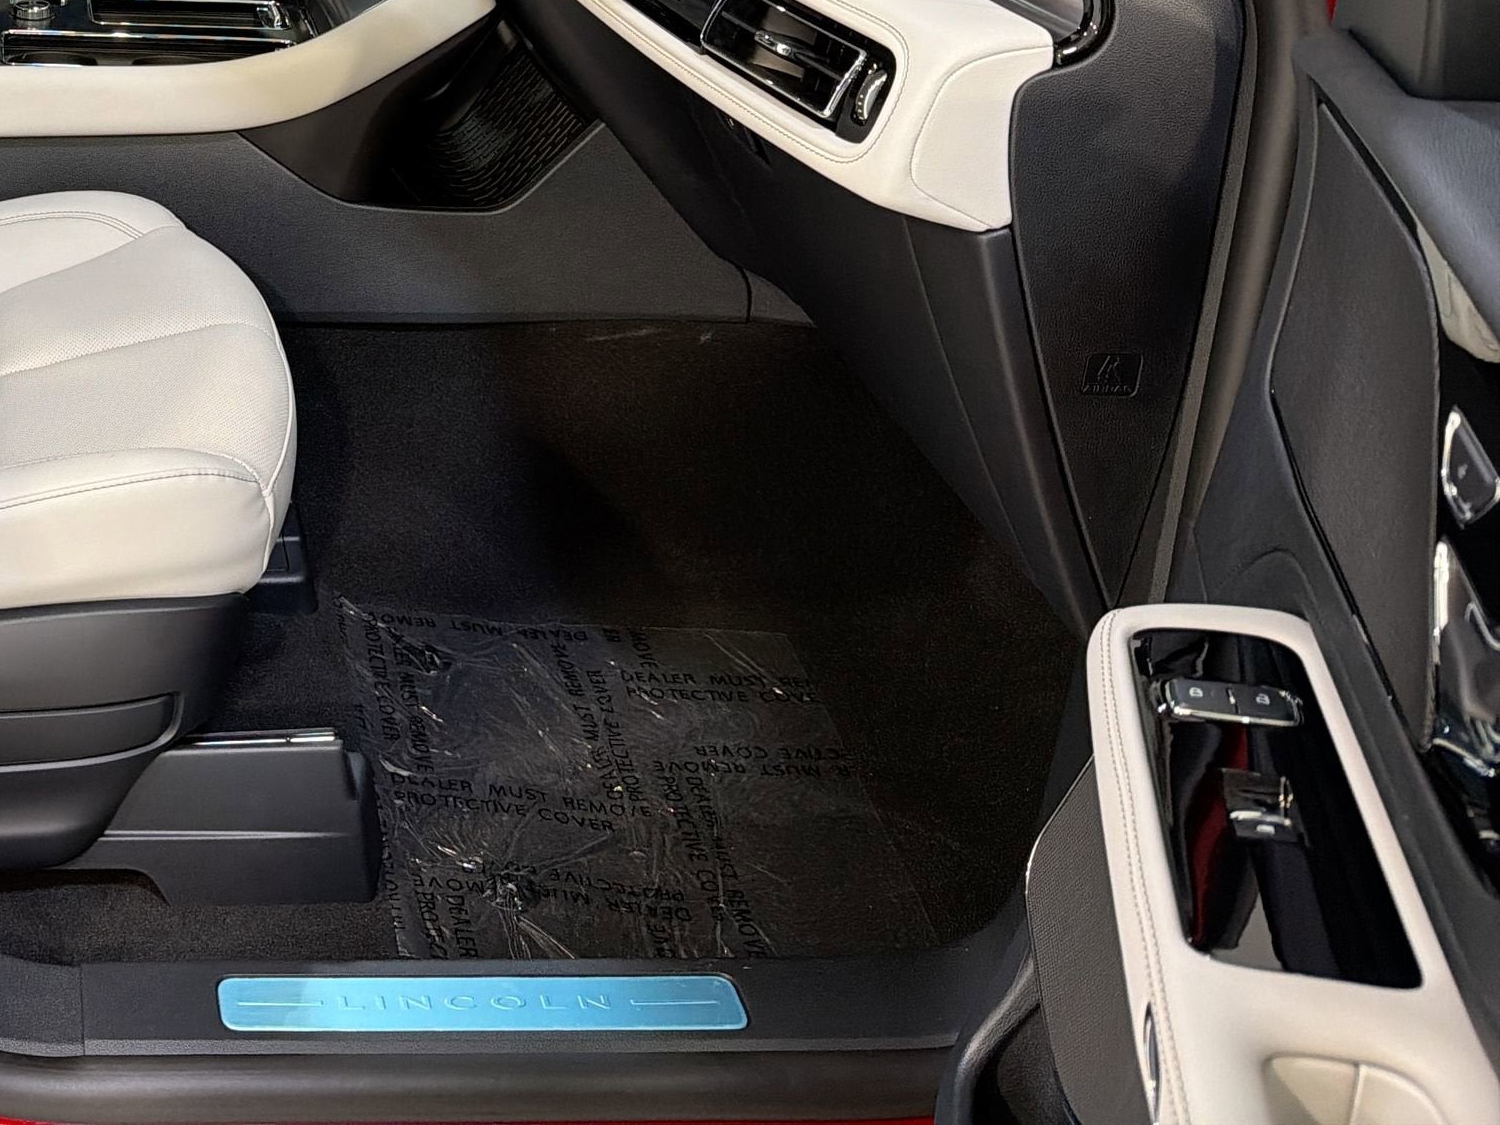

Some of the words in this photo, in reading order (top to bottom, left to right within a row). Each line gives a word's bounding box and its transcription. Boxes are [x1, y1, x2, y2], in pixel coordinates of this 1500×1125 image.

[450, 620, 504, 636] MUST
[516, 627, 588, 642] DEALER
[551, 643, 584, 697] REMOVE
[620, 670, 697, 686] DEALER
[709, 673, 764, 688] MUST
[626, 687, 750, 703] PROTECTIVE
[376, 695, 400, 742] COVER
[573, 704, 599, 741] MUST
[409, 716, 435, 773] REMOVE
[604, 718, 646, 802] PROTECTIVE
[692, 745, 768, 759] COVER
[651, 761, 747, 774] REMOVE
[760, 764, 821, 777] MUST
[390, 774, 474, 795] DEALER
[488, 783, 550, 803] MUST
[393, 789, 528, 816] PROTECTIVE
[537, 806, 617, 833] COVER
[657, 776, 708, 862] PROTECTIVE
[446, 895, 478, 958] DEALER
[725, 890, 768, 959] REMOVE
[336, 993, 613, 1012] LINCOLN
